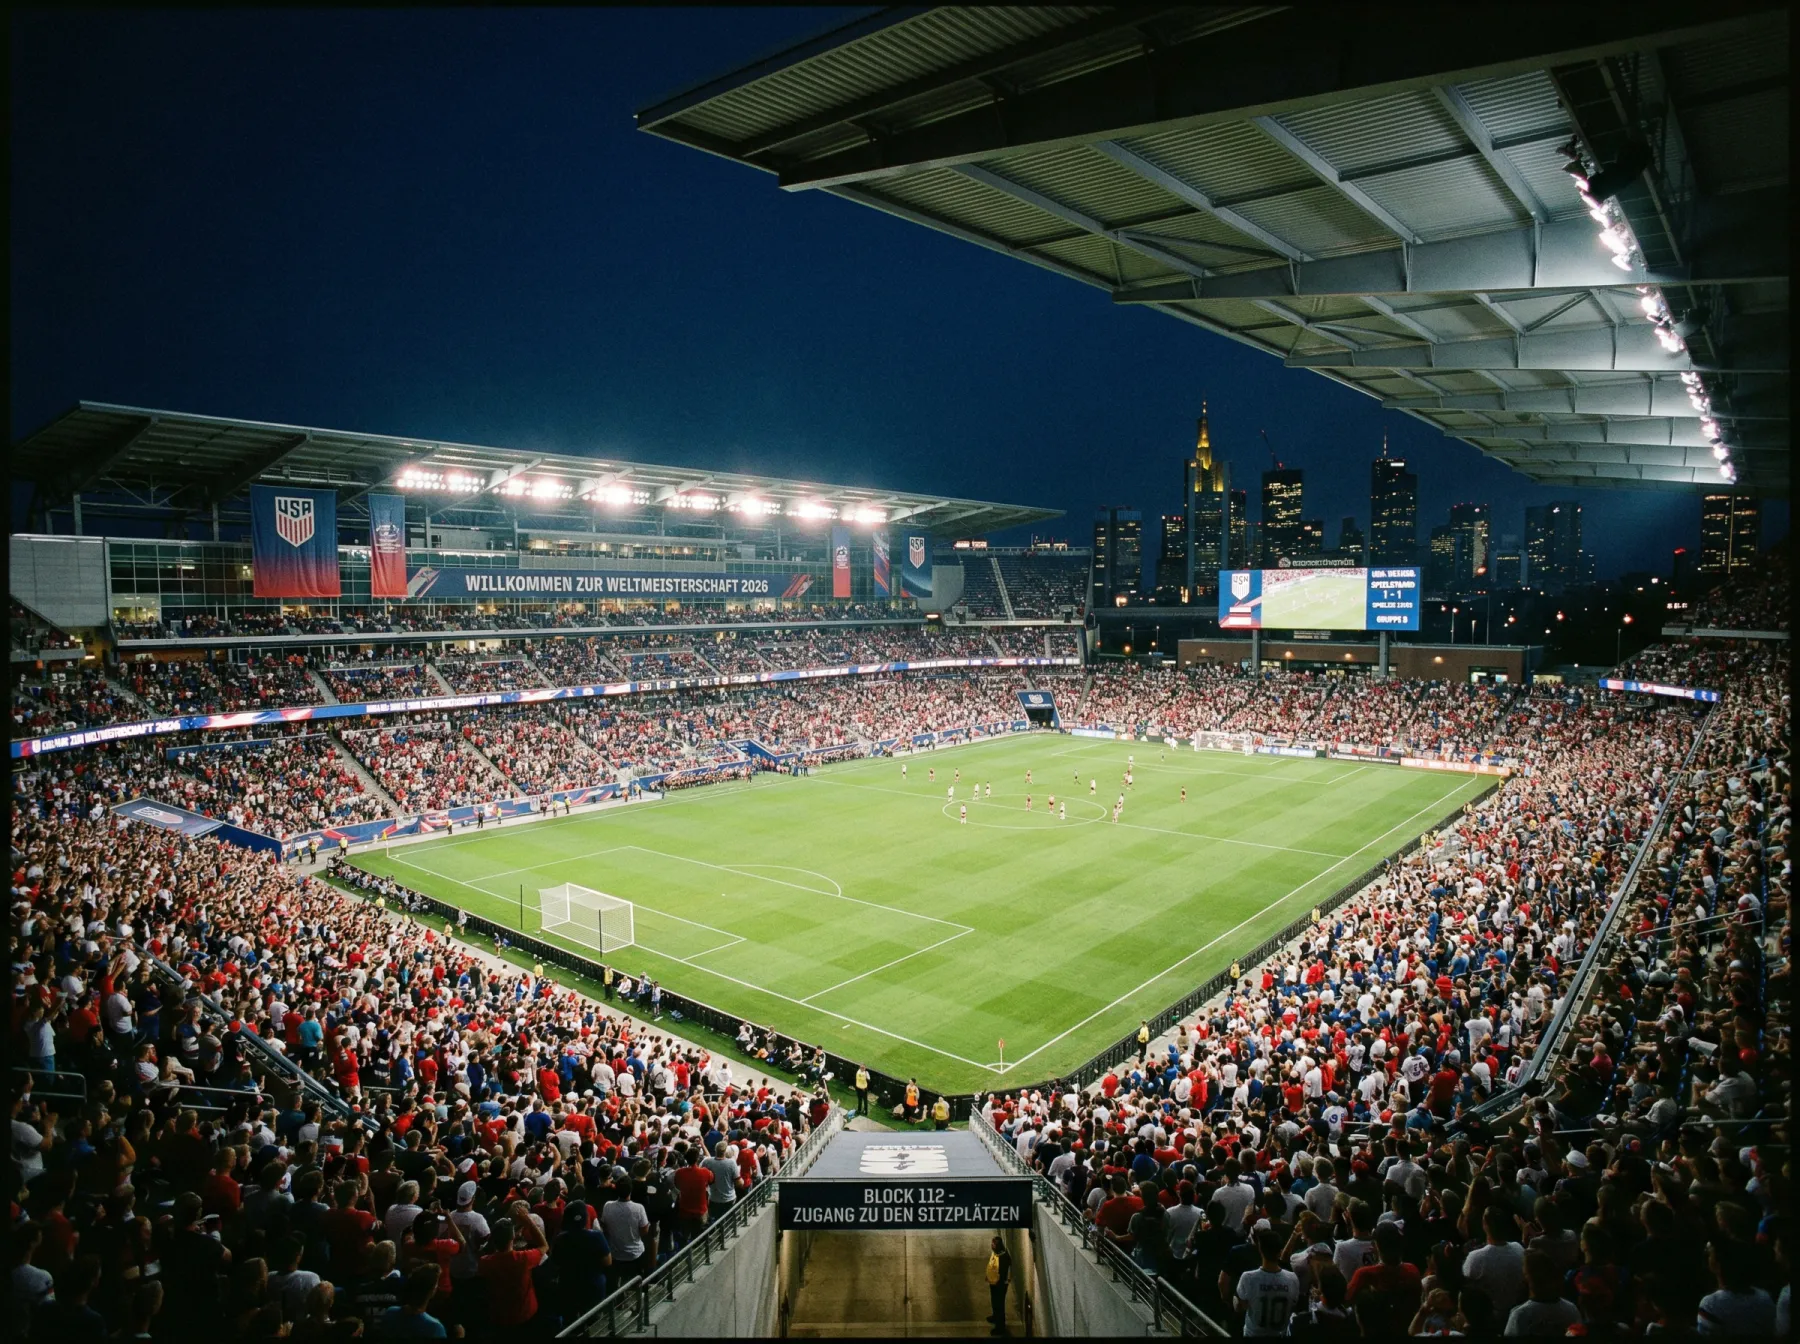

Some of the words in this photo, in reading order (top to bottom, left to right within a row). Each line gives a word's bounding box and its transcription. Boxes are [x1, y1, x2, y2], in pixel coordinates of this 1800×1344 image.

[278, 499, 311, 518] USA
[465, 575, 572, 592] WILLKOMMEN
[576, 577, 603, 592] ZUR
[606, 577, 738, 593] WELTMEISTERSCHAFT
[741, 580, 769, 593] 2026
[1383, 590, 1388, 599] 1
[1396, 590, 1402, 599] 1
[1329, 1113, 1339, 1124] 9
[864, 1188, 914, 1204] BLOCK
[918, 1188, 945, 1204] 112
[793, 1207, 855, 1222] ZUGANG
[859, 1207, 878, 1222] ZU
[883, 1207, 914, 1222] DEN
[918, 1203, 1020, 1222] SITZPLÄTZEN
[1259, 1296, 1289, 1328] 10
